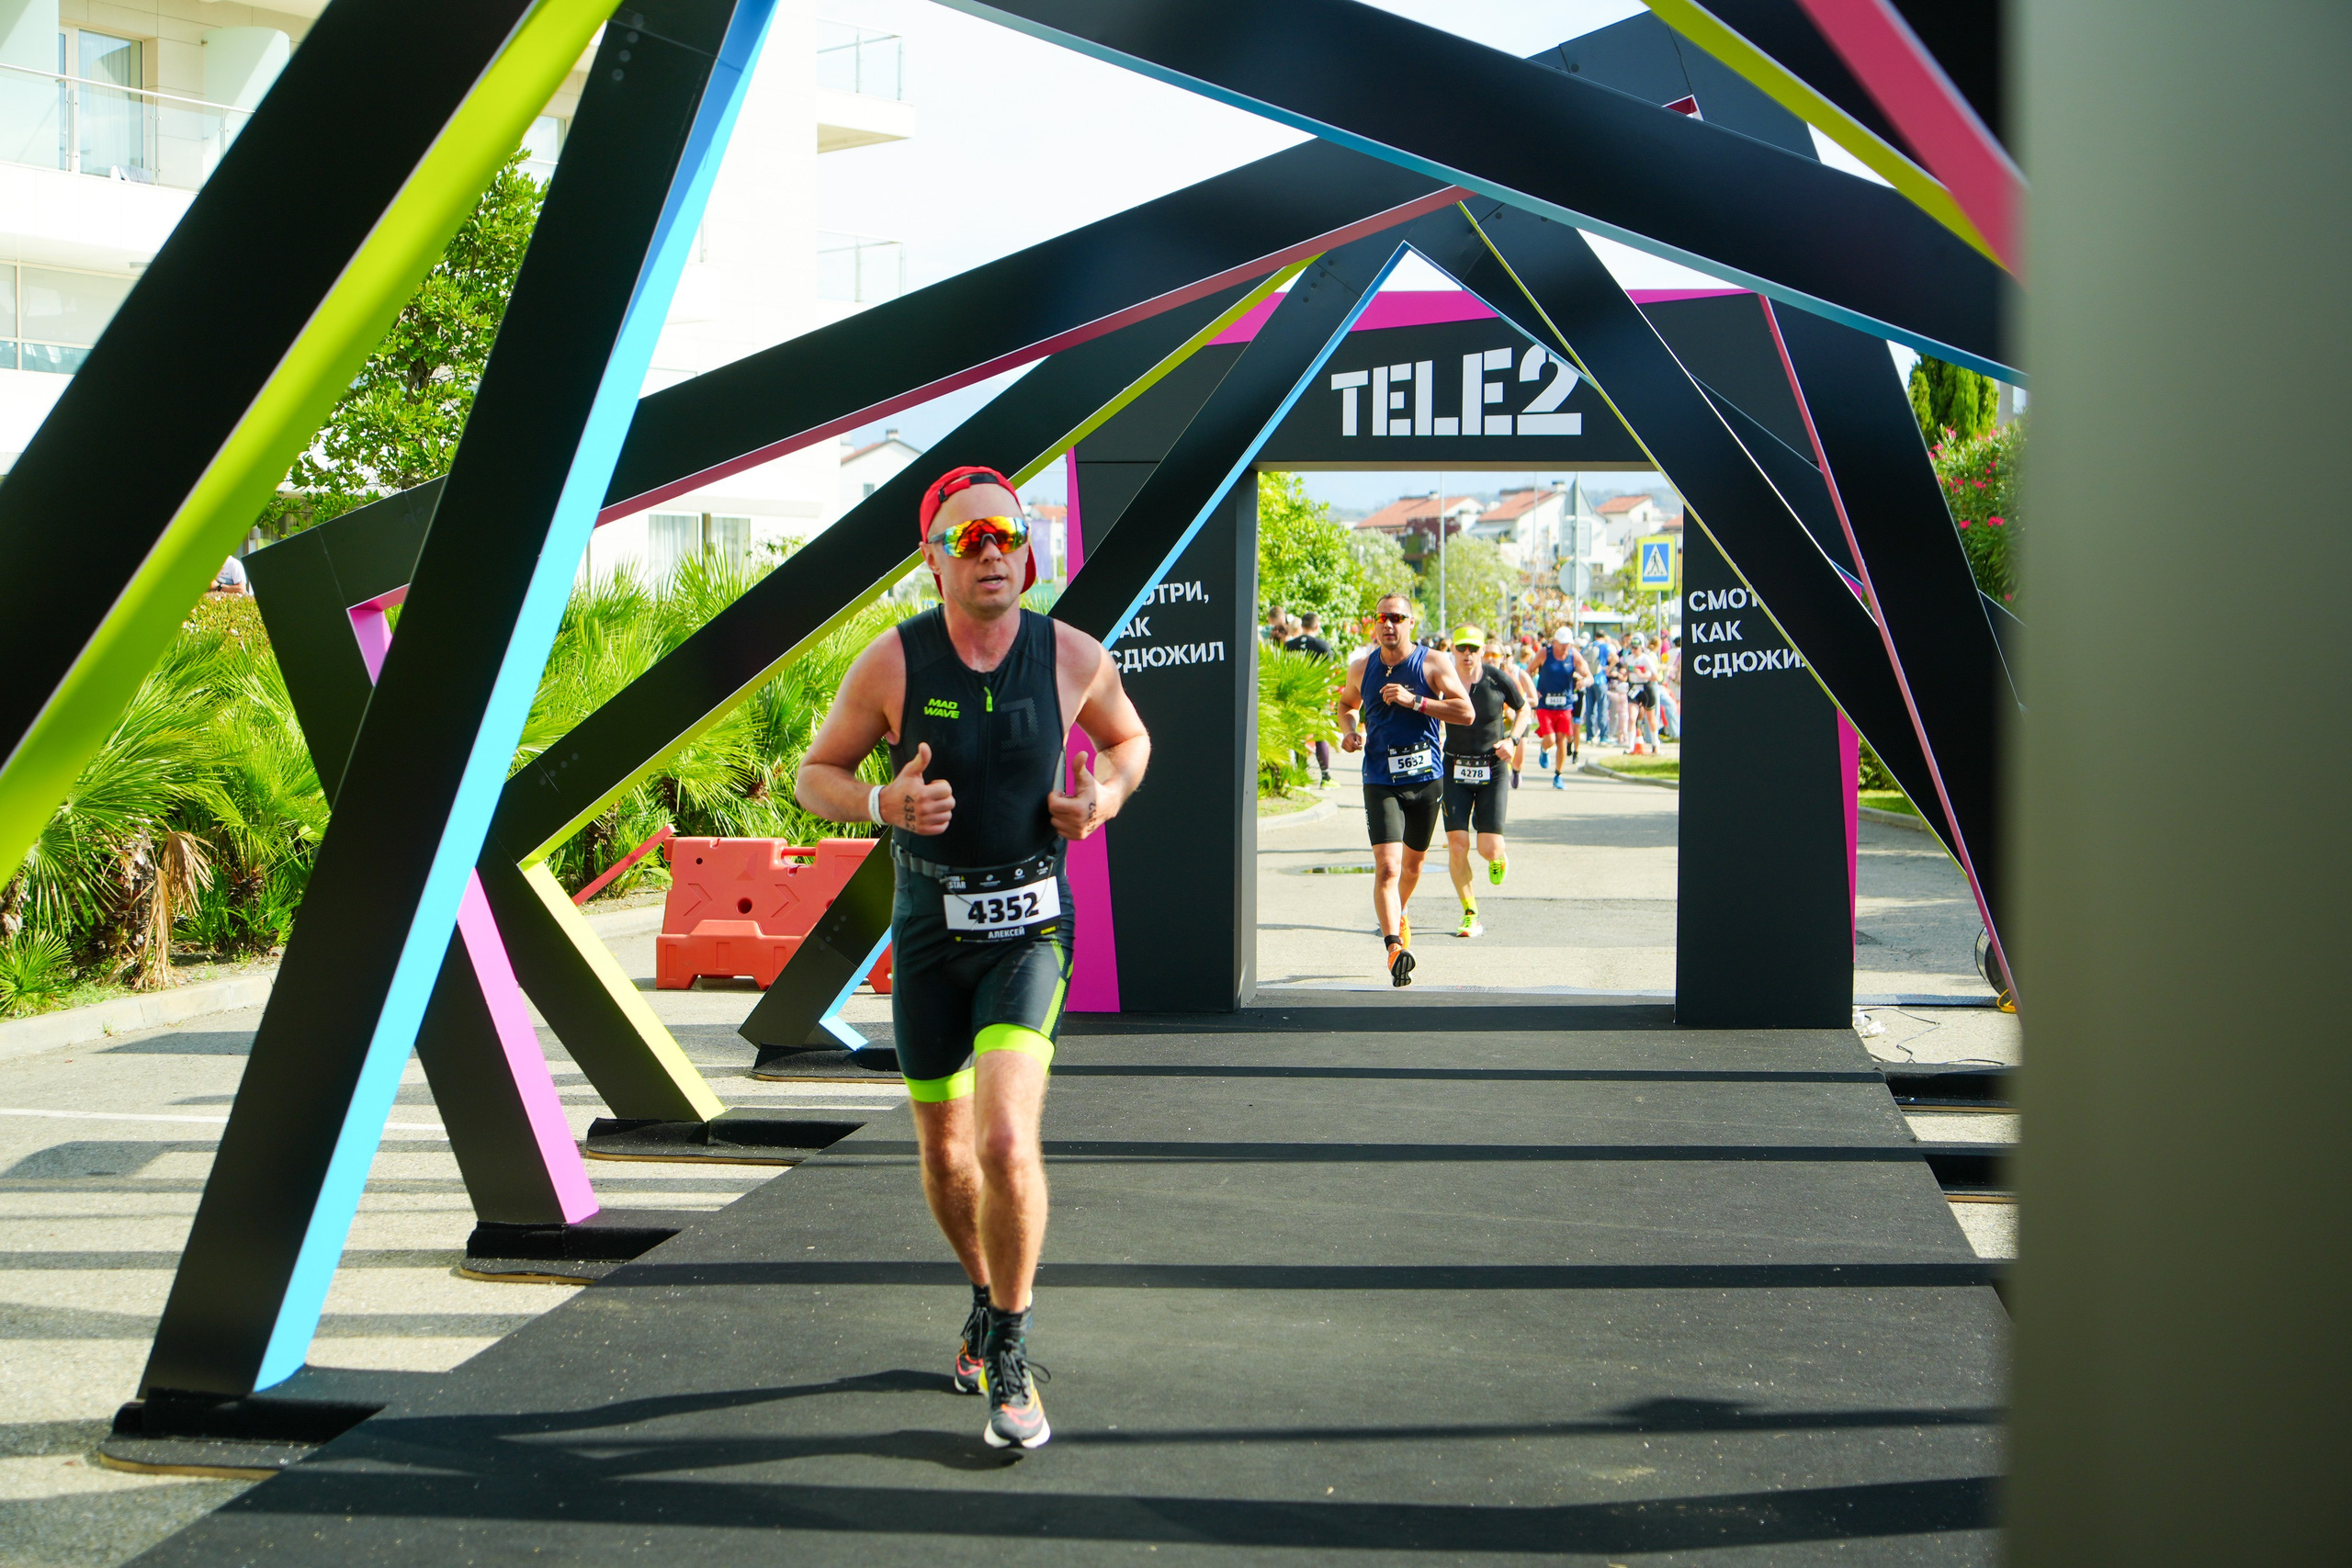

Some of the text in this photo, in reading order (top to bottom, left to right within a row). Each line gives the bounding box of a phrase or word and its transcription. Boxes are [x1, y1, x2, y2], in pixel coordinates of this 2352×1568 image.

[1331, 344, 1582, 437] TELE2
[1143, 581, 1209, 606] ТРИ,
[1689, 588, 1758, 612] СМОТ
[1119, 616, 1152, 638] АК
[1691, 620, 1743, 643] КАК
[1693, 649, 1806, 679] СДЮЖИ
[923, 706, 960, 719] WAVE
[928, 698, 958, 710] MAD
[1460, 768, 1484, 778] 4278
[948, 881, 967, 889] STAR
[967, 892, 1039, 924] 4352
[988, 926, 1025, 939] АЛЕКСЕЙ
